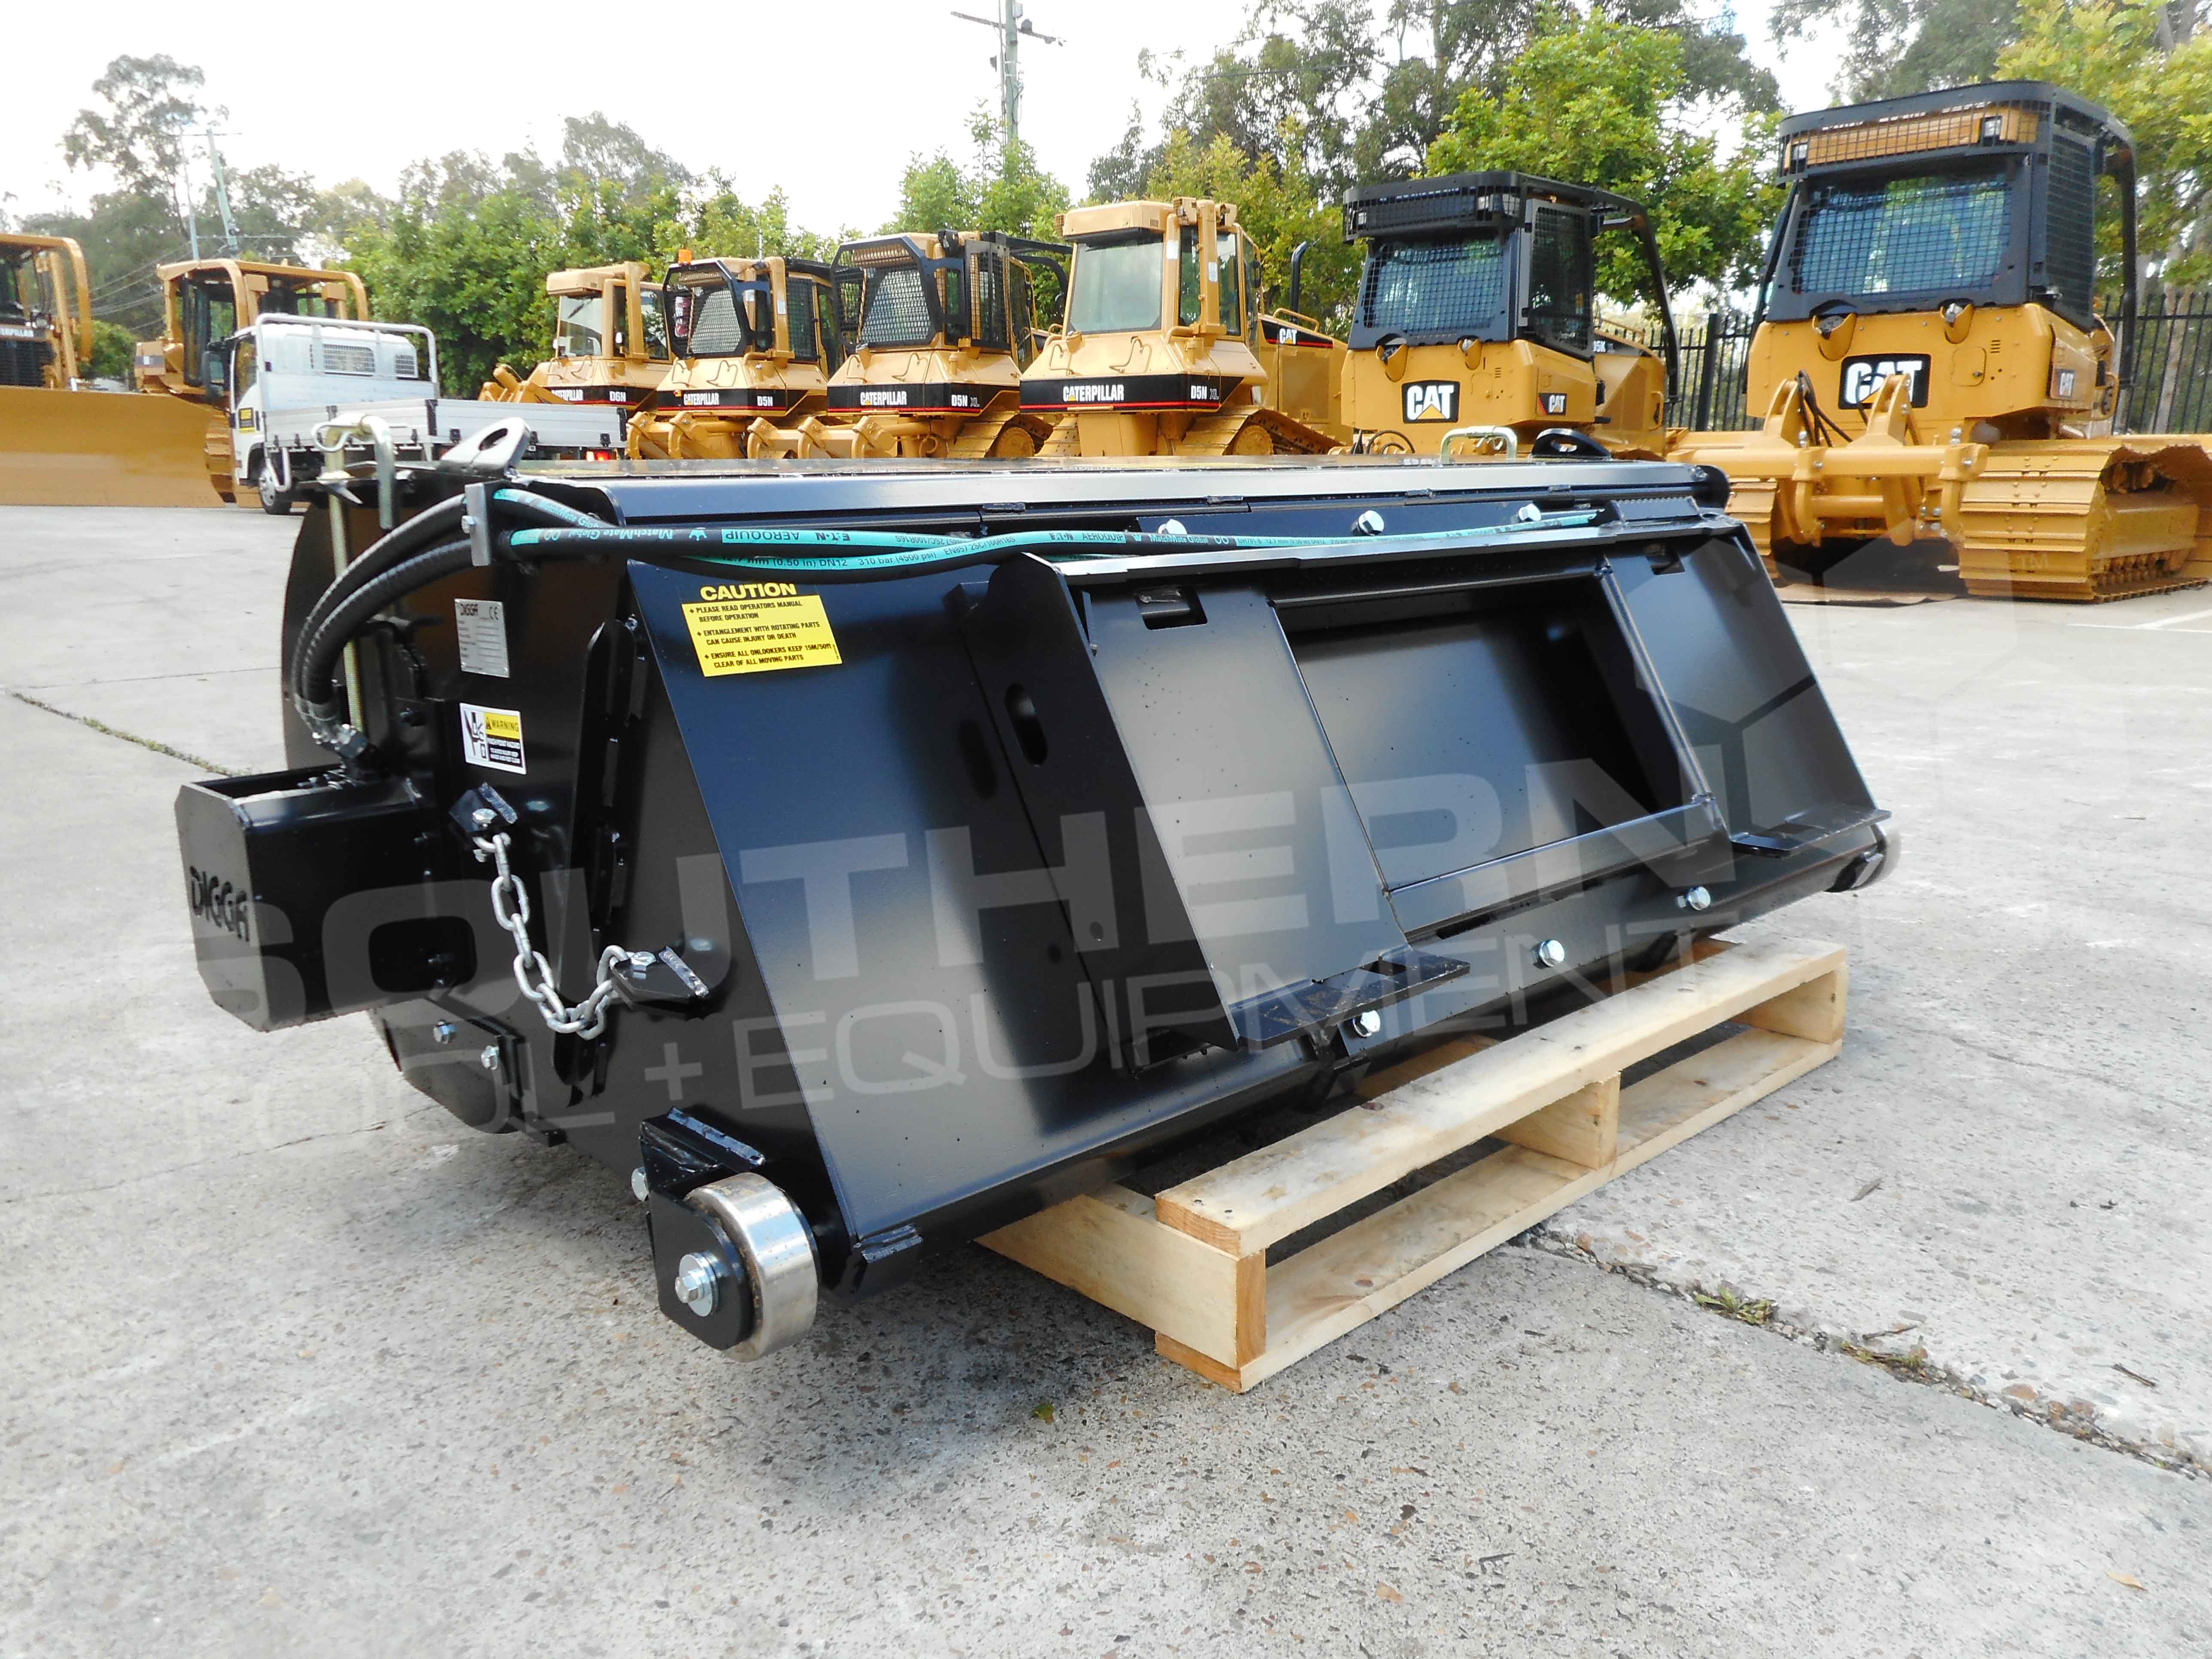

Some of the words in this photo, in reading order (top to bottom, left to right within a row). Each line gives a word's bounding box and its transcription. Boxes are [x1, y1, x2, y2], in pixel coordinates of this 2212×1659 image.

[1279, 328, 1297, 344] CAT
[1844, 361, 1922, 404] CAT
[609, 391, 626, 402] D6N
[684, 393, 719, 406] CATERPILLAR
[860, 391, 907, 406] CATERPILLAR
[1063, 385, 1124, 401] CATERPILLAR
[1191, 385, 1207, 400] D5N
[1209, 389, 1219, 401] XL
[757, 396, 773, 407] D5N
[951, 394, 968, 407] D5N
[970, 397, 980, 407] XL
[1407, 385, 1455, 420] CAT
[1549, 395, 1565, 413] CAT
[603, 529, 673, 539] MatchMate
[725, 530, 799, 541] AEROQUIP
[803, 559, 817, 568] in)
[896, 554, 919, 564] (4500
[921, 552, 937, 561] psi)
[944, 545, 968, 555] EN857
[1082, 533, 1124, 541] AEROQUIP
[1150, 534, 1187, 543] MatchMate
[1187, 535, 1209, 544] Global
[701, 583, 796, 601] CAUTION
[696, 605, 720, 614] PLEASE
[740, 602, 775, 610] OPERATORS
[725, 613, 759, 621] OPERATION
[704, 627, 752, 636] ENTANGLEMENT
[744, 635, 765, 643] INJURY
[711, 651, 735, 659] ENSURE
[751, 647, 786, 656] ONLOOKERS
[491, 719, 519, 732] WARNING
[189, 866, 250, 942] DIGGA
